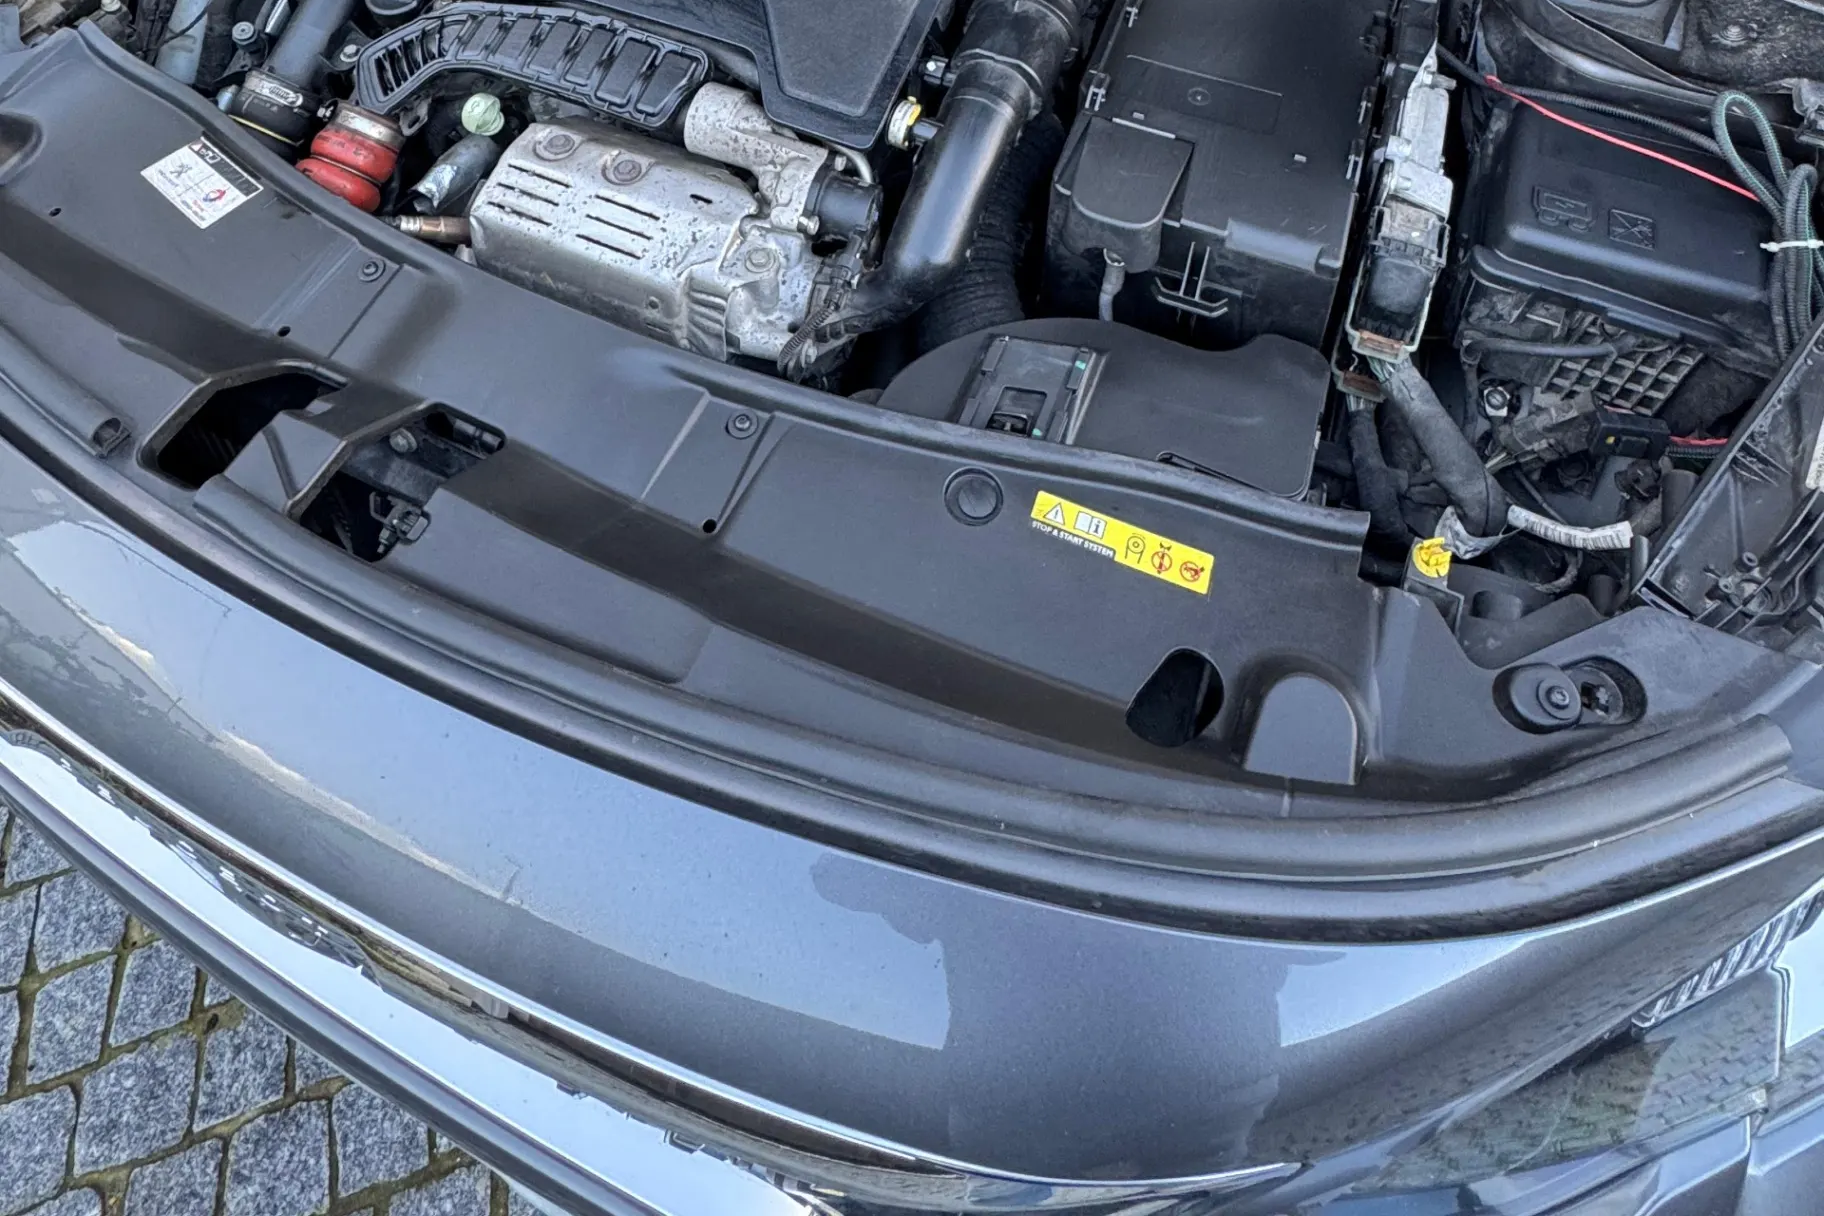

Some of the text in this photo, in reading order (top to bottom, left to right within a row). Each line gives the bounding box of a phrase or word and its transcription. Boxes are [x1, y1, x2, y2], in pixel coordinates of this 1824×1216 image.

[1031, 520, 1052, 533] STOP
[1059, 532, 1083, 546] START
[1083, 541, 1114, 557] SYSTEM
